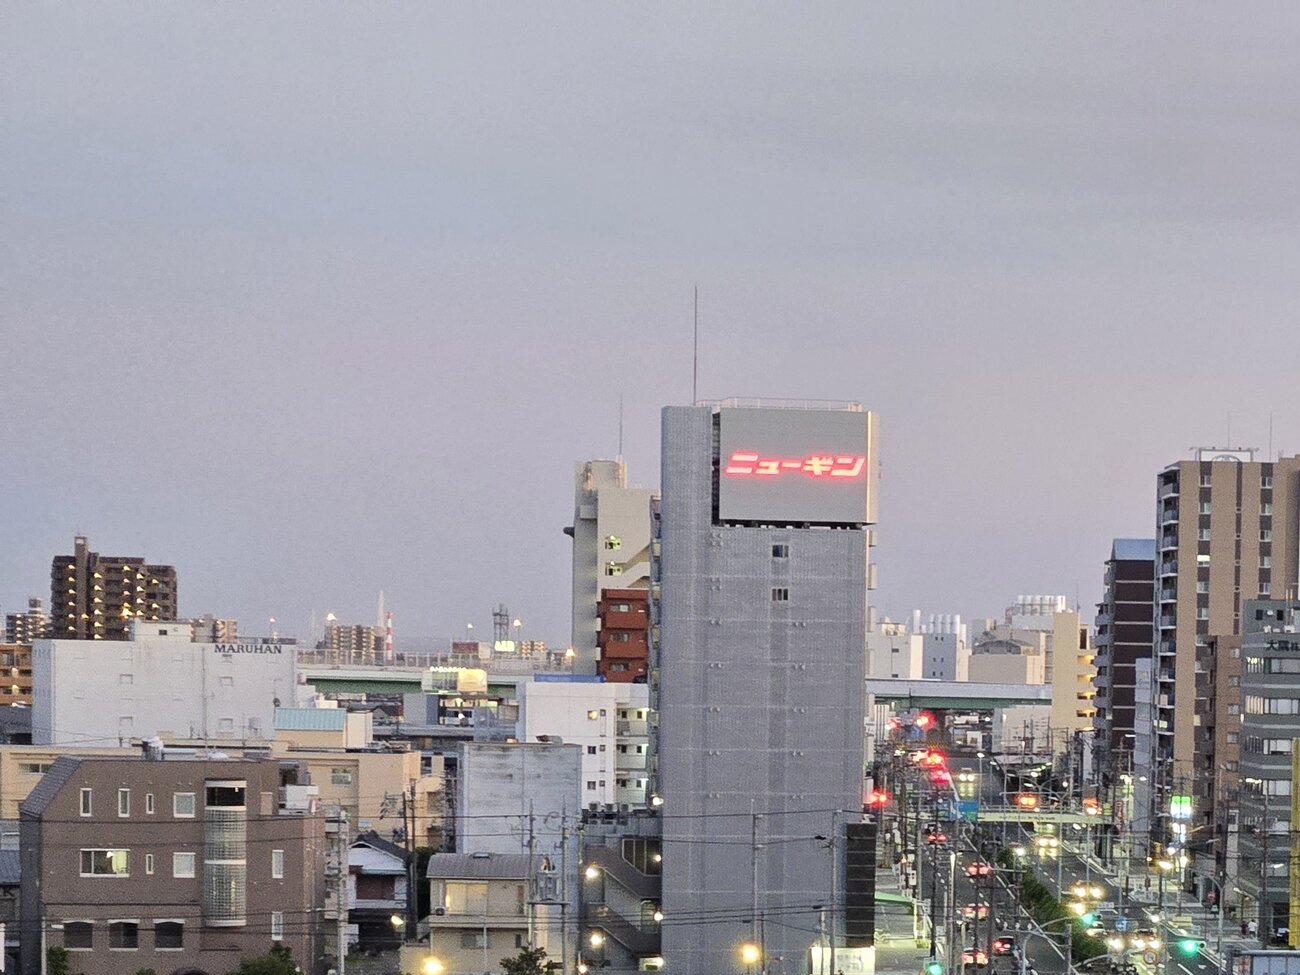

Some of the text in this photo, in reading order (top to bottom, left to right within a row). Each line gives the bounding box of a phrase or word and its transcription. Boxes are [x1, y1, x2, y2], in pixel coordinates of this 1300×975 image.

[726, 454, 865, 477] ニューギン
[214, 644, 282, 654] MARUHAN
